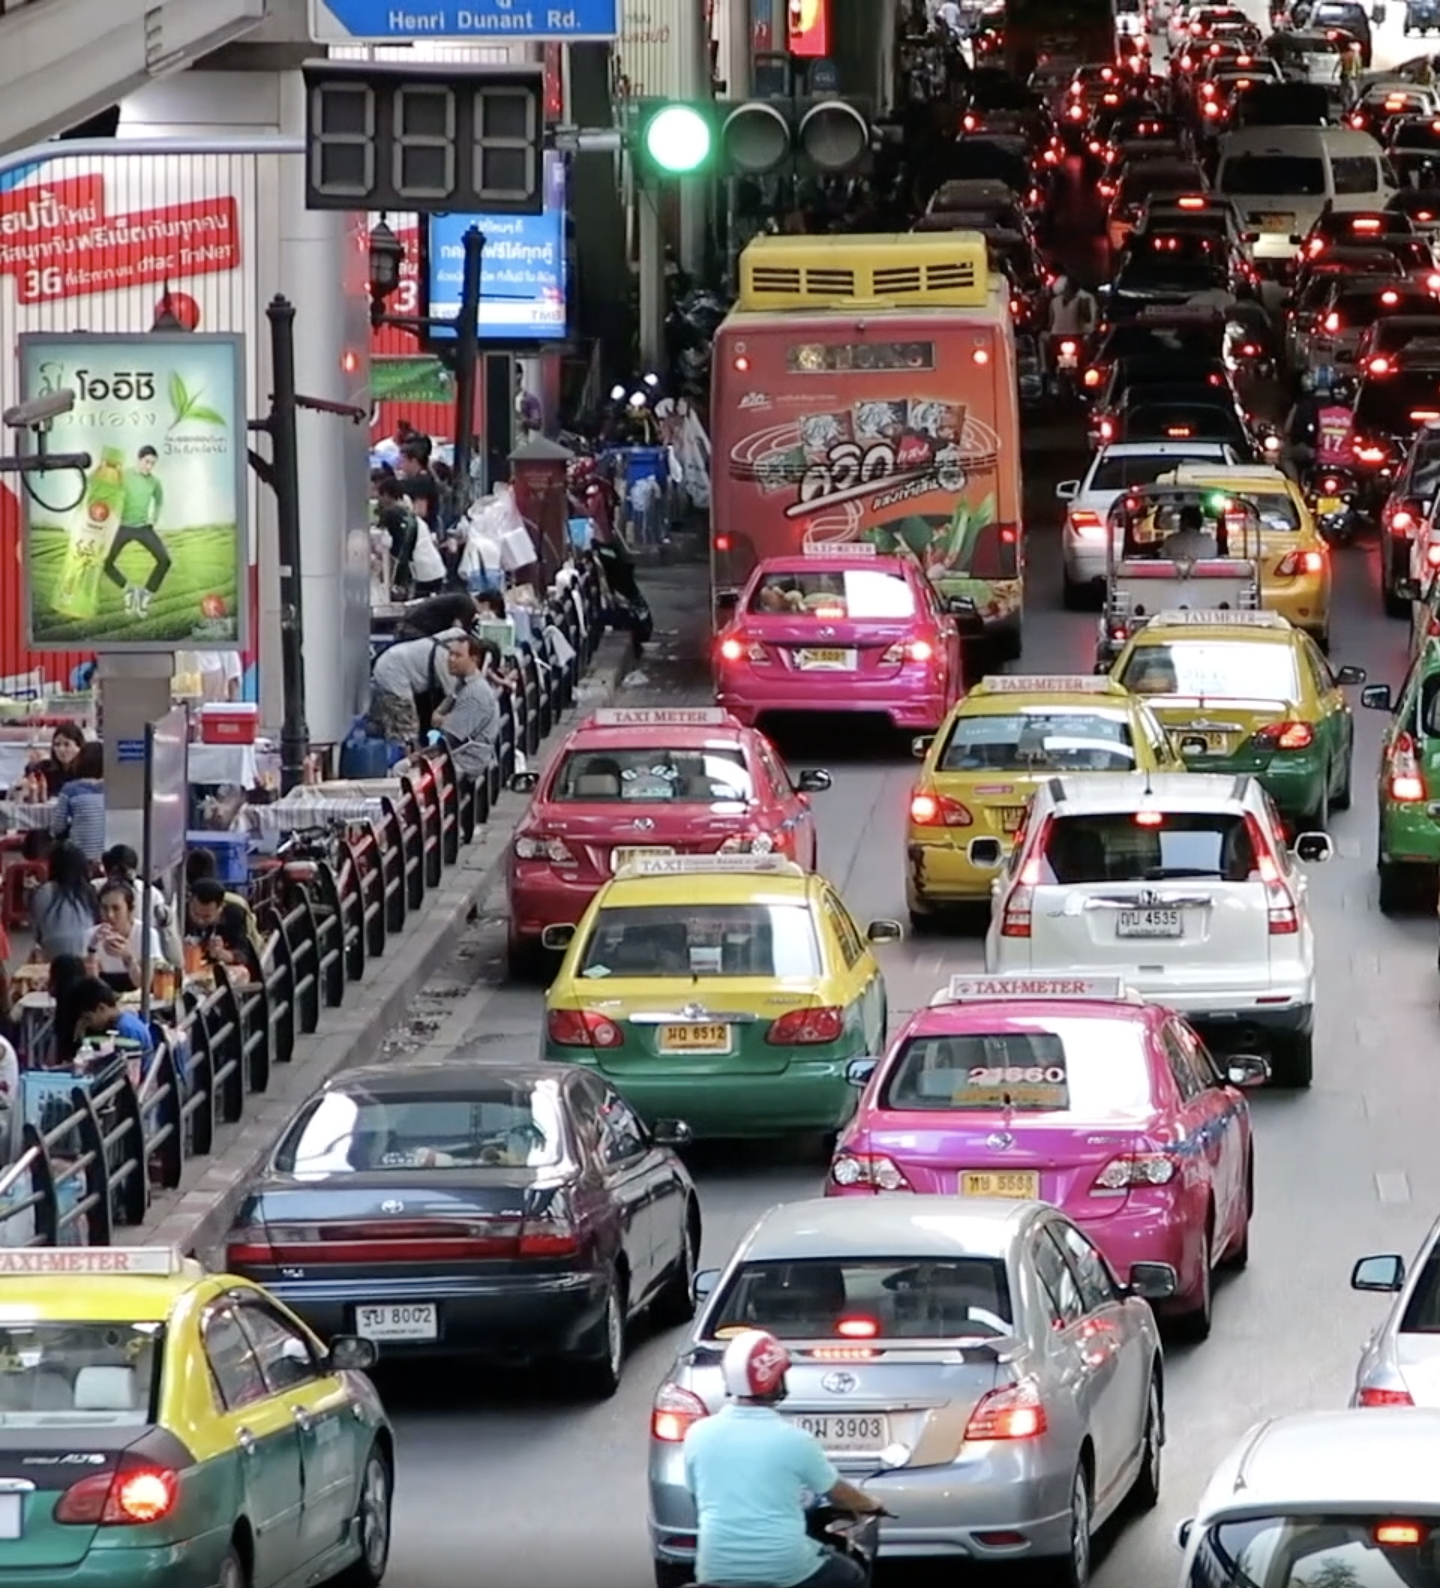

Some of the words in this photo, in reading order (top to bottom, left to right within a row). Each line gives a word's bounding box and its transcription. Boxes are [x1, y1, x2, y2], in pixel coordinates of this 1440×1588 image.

[389, 11, 445, 30] Henri
[458, 11, 533, 30] Dunant
[547, 11, 581, 29] Rd.
[75, 370, 155, 401] โออิชิ
[1323, 434, 1343, 452] 17
[1001, 678, 1083, 690] TAXI-METER
[614, 711, 650, 723] TAXI
[654, 711, 707, 723] METER
[641, 860, 682, 872] TAXI
[1145, 911, 1178, 925] 4535
[975, 980, 1085, 995] TAXI-METER
[692, 1025, 725, 1040] 6512
[0, 1251, 130, 1271] AXI-METER
[391, 1306, 432, 1324] 8002
[834, 1418, 881, 1438] 3903
